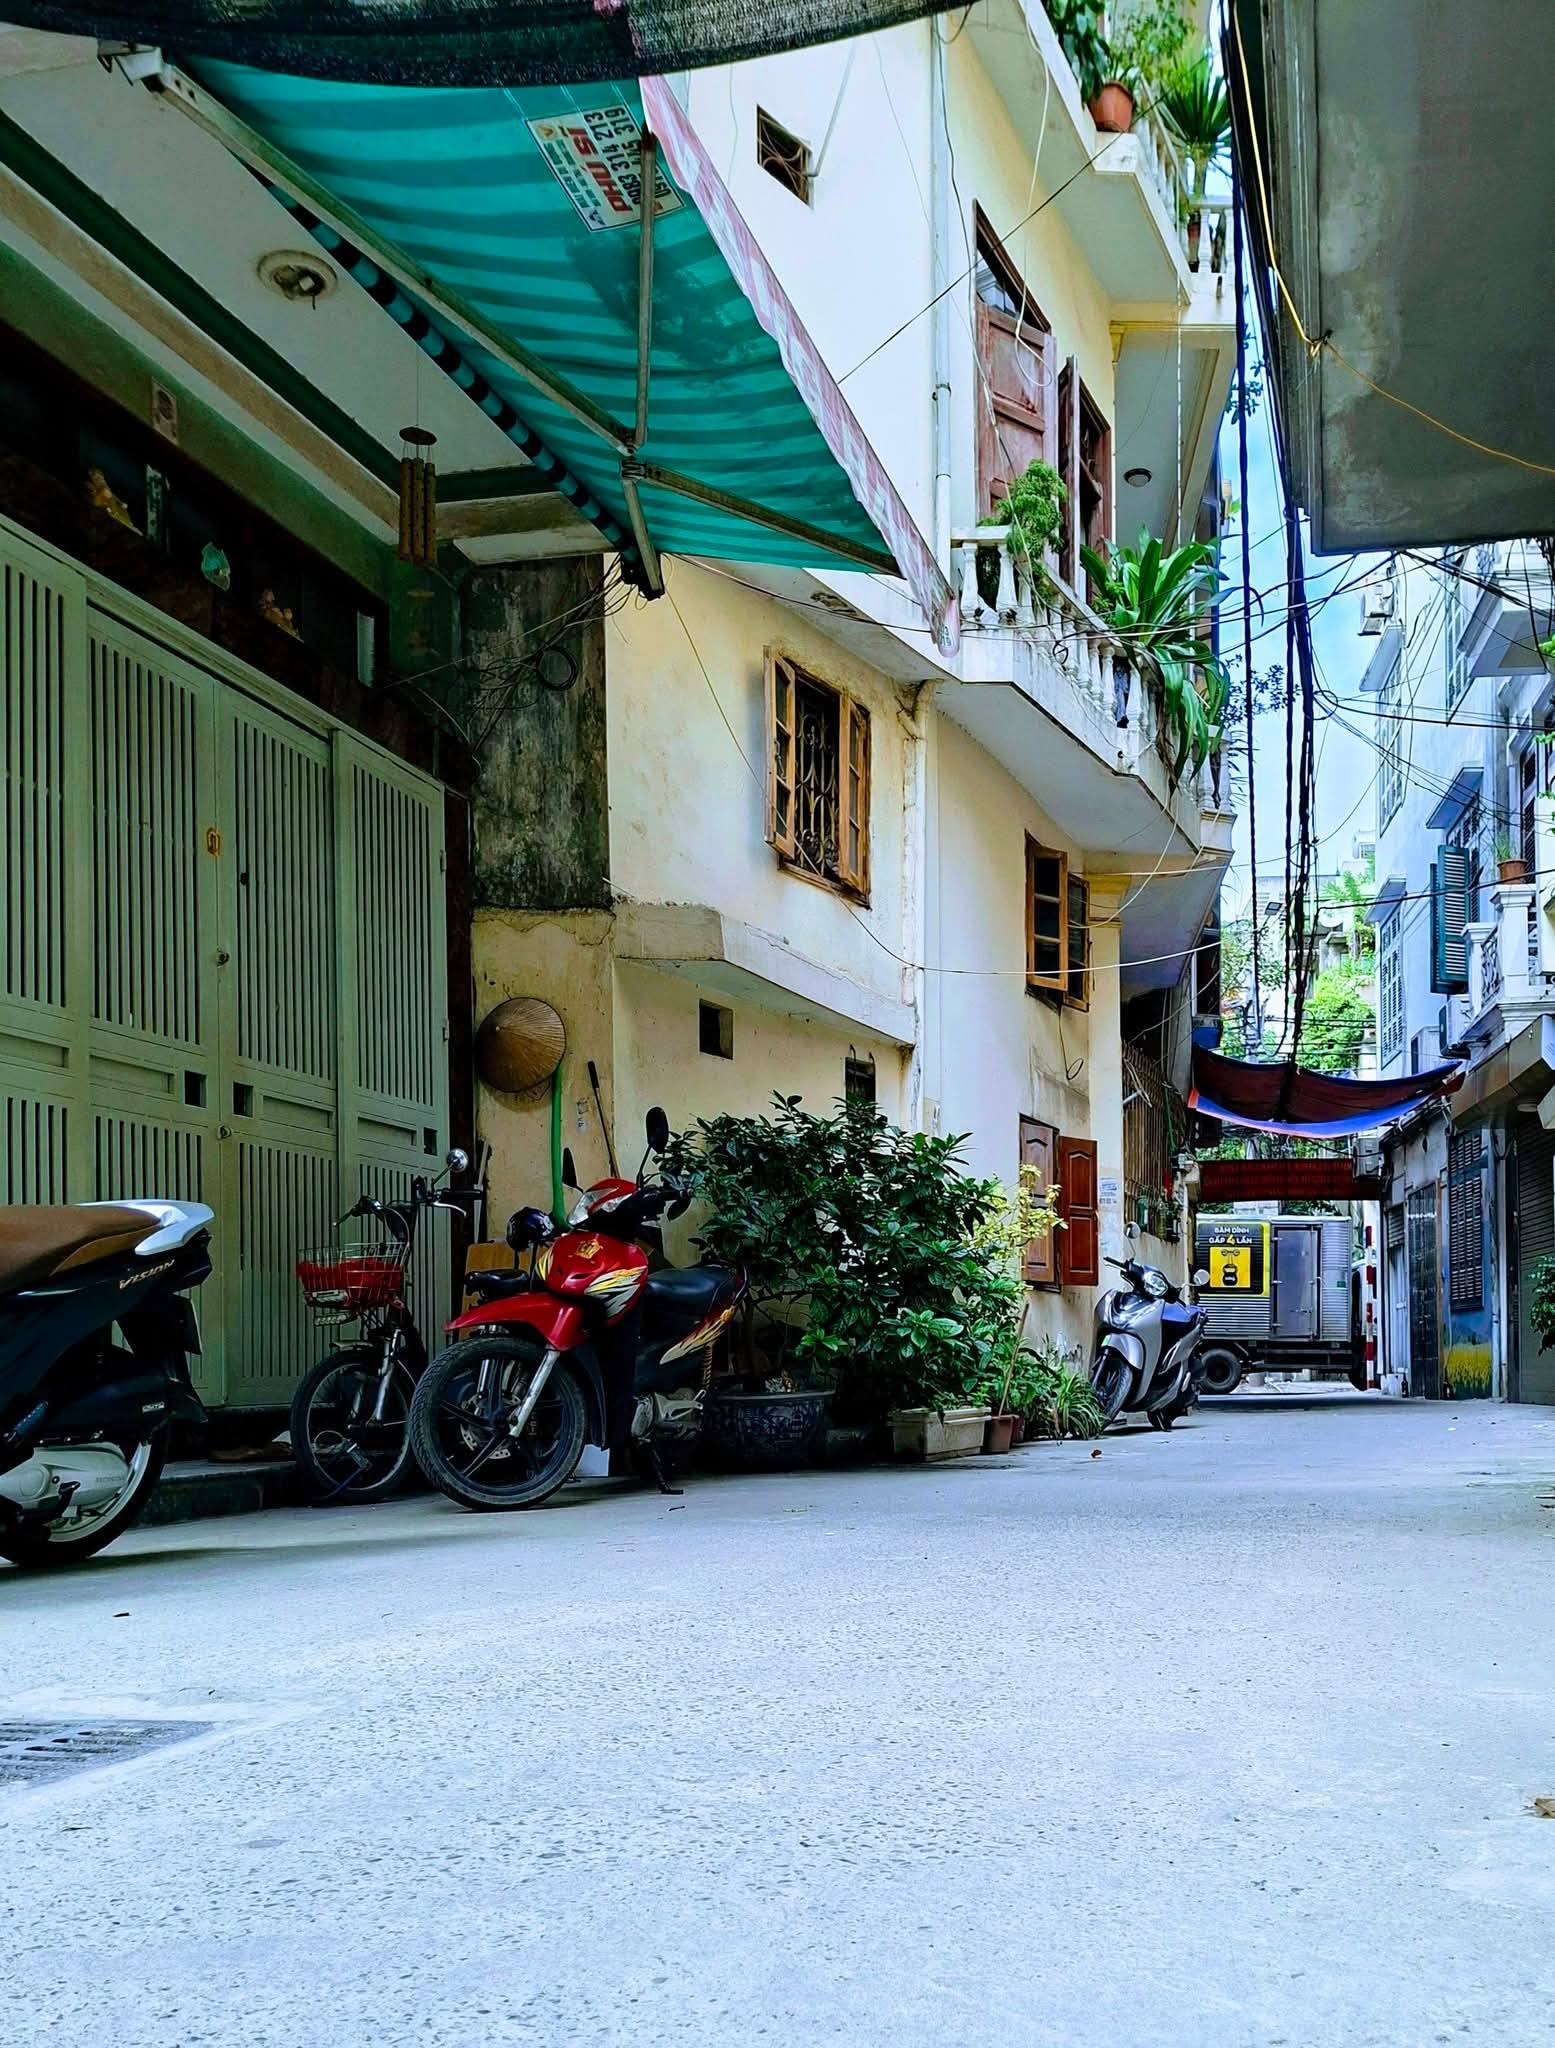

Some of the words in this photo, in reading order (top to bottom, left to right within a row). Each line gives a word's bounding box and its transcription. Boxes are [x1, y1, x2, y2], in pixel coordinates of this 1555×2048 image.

[584, 112, 615, 141] 213
[605, 108, 636, 135] 319
[602, 144, 631, 172] 314
[1226, 1234, 1236, 1245] 4
[119, 1258, 175, 1289] VISION
